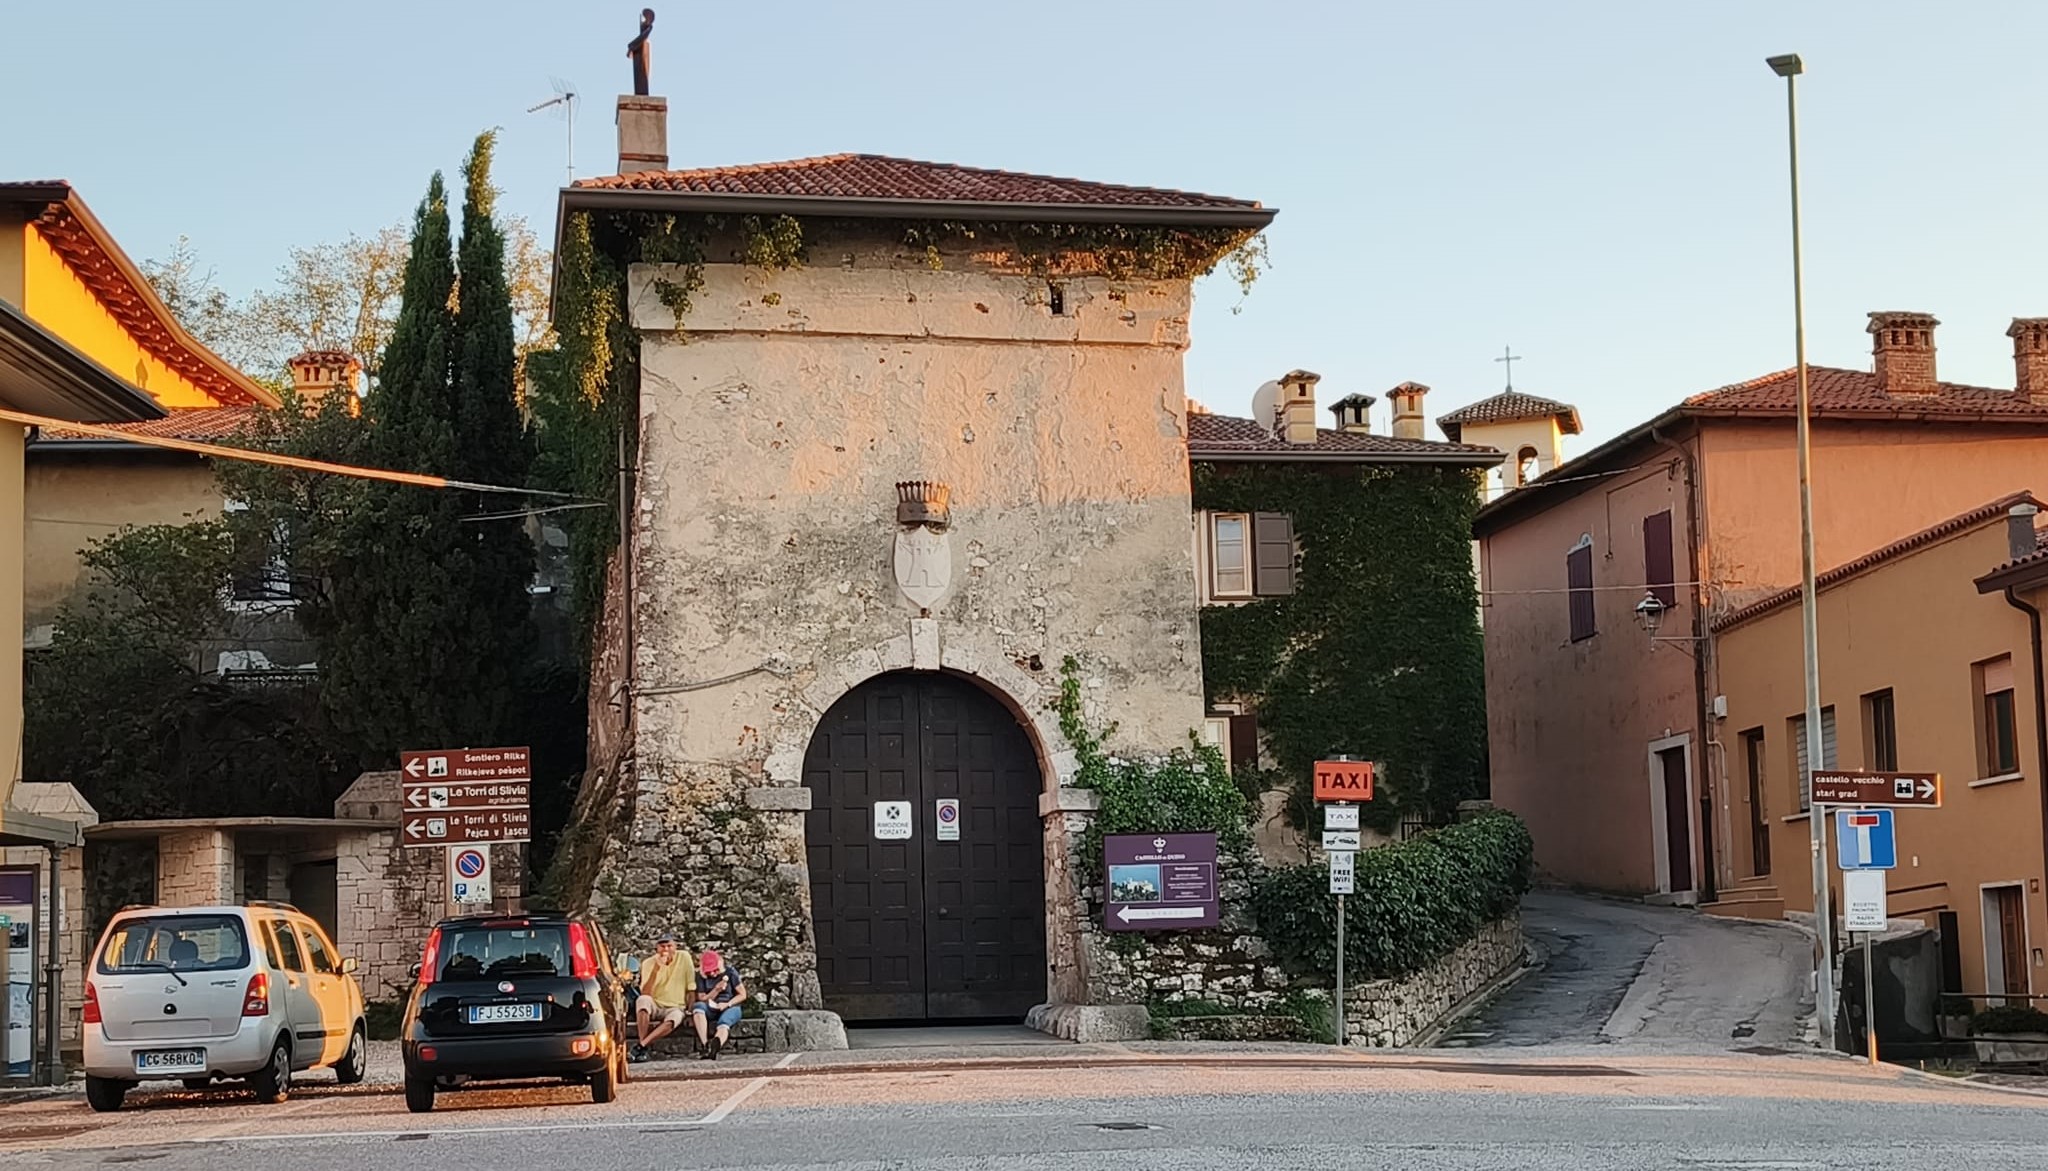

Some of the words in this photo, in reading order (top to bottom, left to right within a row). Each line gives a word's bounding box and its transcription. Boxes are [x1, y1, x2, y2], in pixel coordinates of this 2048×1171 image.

[464, 753, 501, 763] Sentiero
[503, 752, 526, 761] Rilke
[455, 767, 495, 777] Rilkejeva
[498, 765, 526, 776] pešpot
[1317, 772, 1368, 789] TAXI
[1815, 775, 1850, 784] castello
[1852, 776, 1885, 785] vecchio
[449, 787, 463, 797] Le
[464, 786, 487, 796] Torri
[488, 786, 498, 796] di
[499, 785, 527, 796] Slivia
[1815, 789, 1835, 798] stari
[1838, 790, 1857, 798] grad
[449, 816, 460, 825] Le
[464, 815, 485, 825] Torri
[489, 814, 498, 824] di
[502, 812, 528, 823] Slivia
[465, 828, 490, 839] Pejca
[493, 828, 500, 837] v
[457, 884, 465, 894] P
[478, 1007, 493, 1019] FJ
[496, 1005, 533, 1019] 552SB
